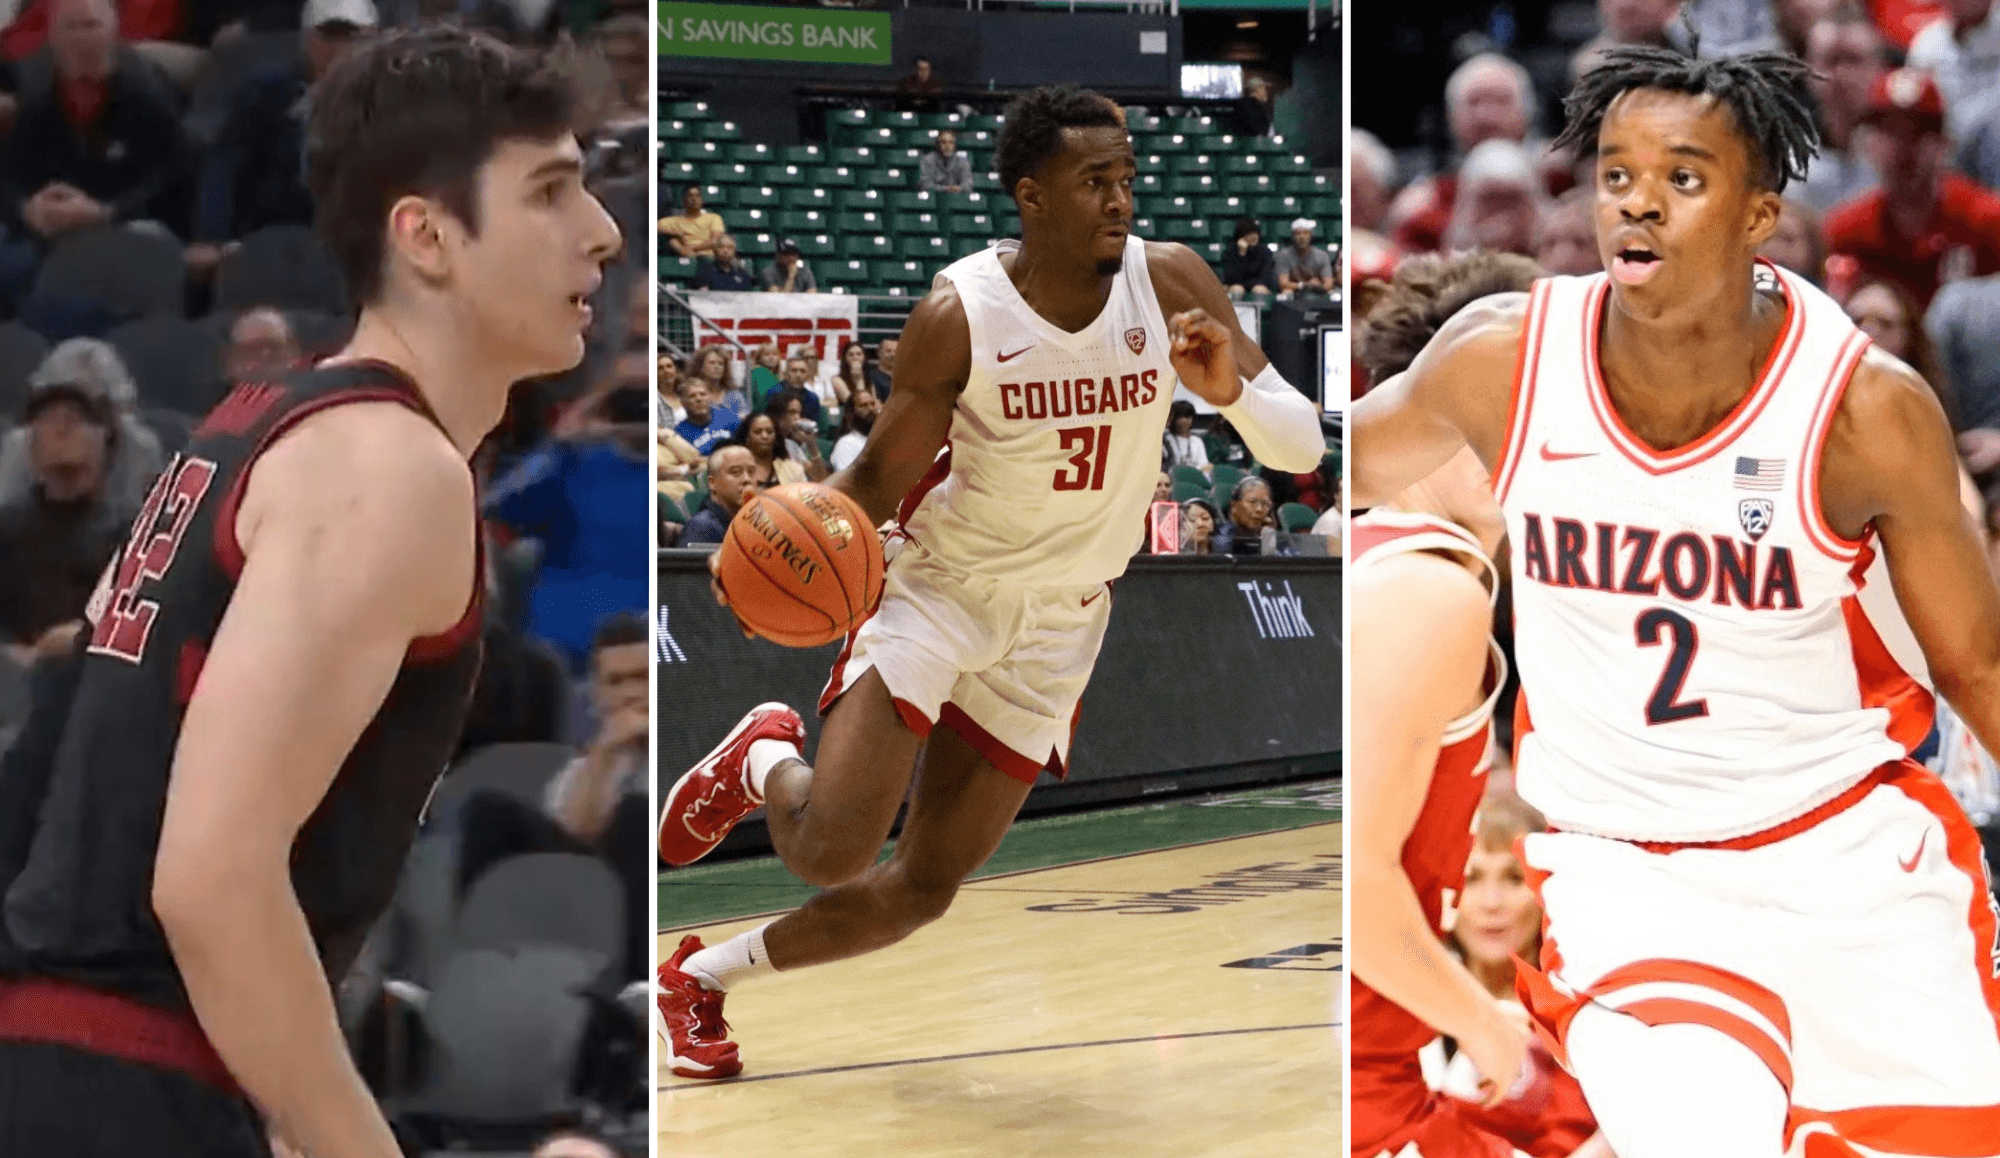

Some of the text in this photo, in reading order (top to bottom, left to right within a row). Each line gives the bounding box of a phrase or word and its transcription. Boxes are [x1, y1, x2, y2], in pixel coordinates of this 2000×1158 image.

[681, 17, 796, 47] SAVINGS
[801, 23, 879, 50] BANK
[998, 368, 1158, 420] COUGARS
[1052, 425, 1112, 491] 31
[742, 500, 823, 586] SPALDING
[1523, 512, 1803, 611] ARIZONA
[1237, 579, 1316, 639] Think
[1634, 607, 1710, 727] 2
